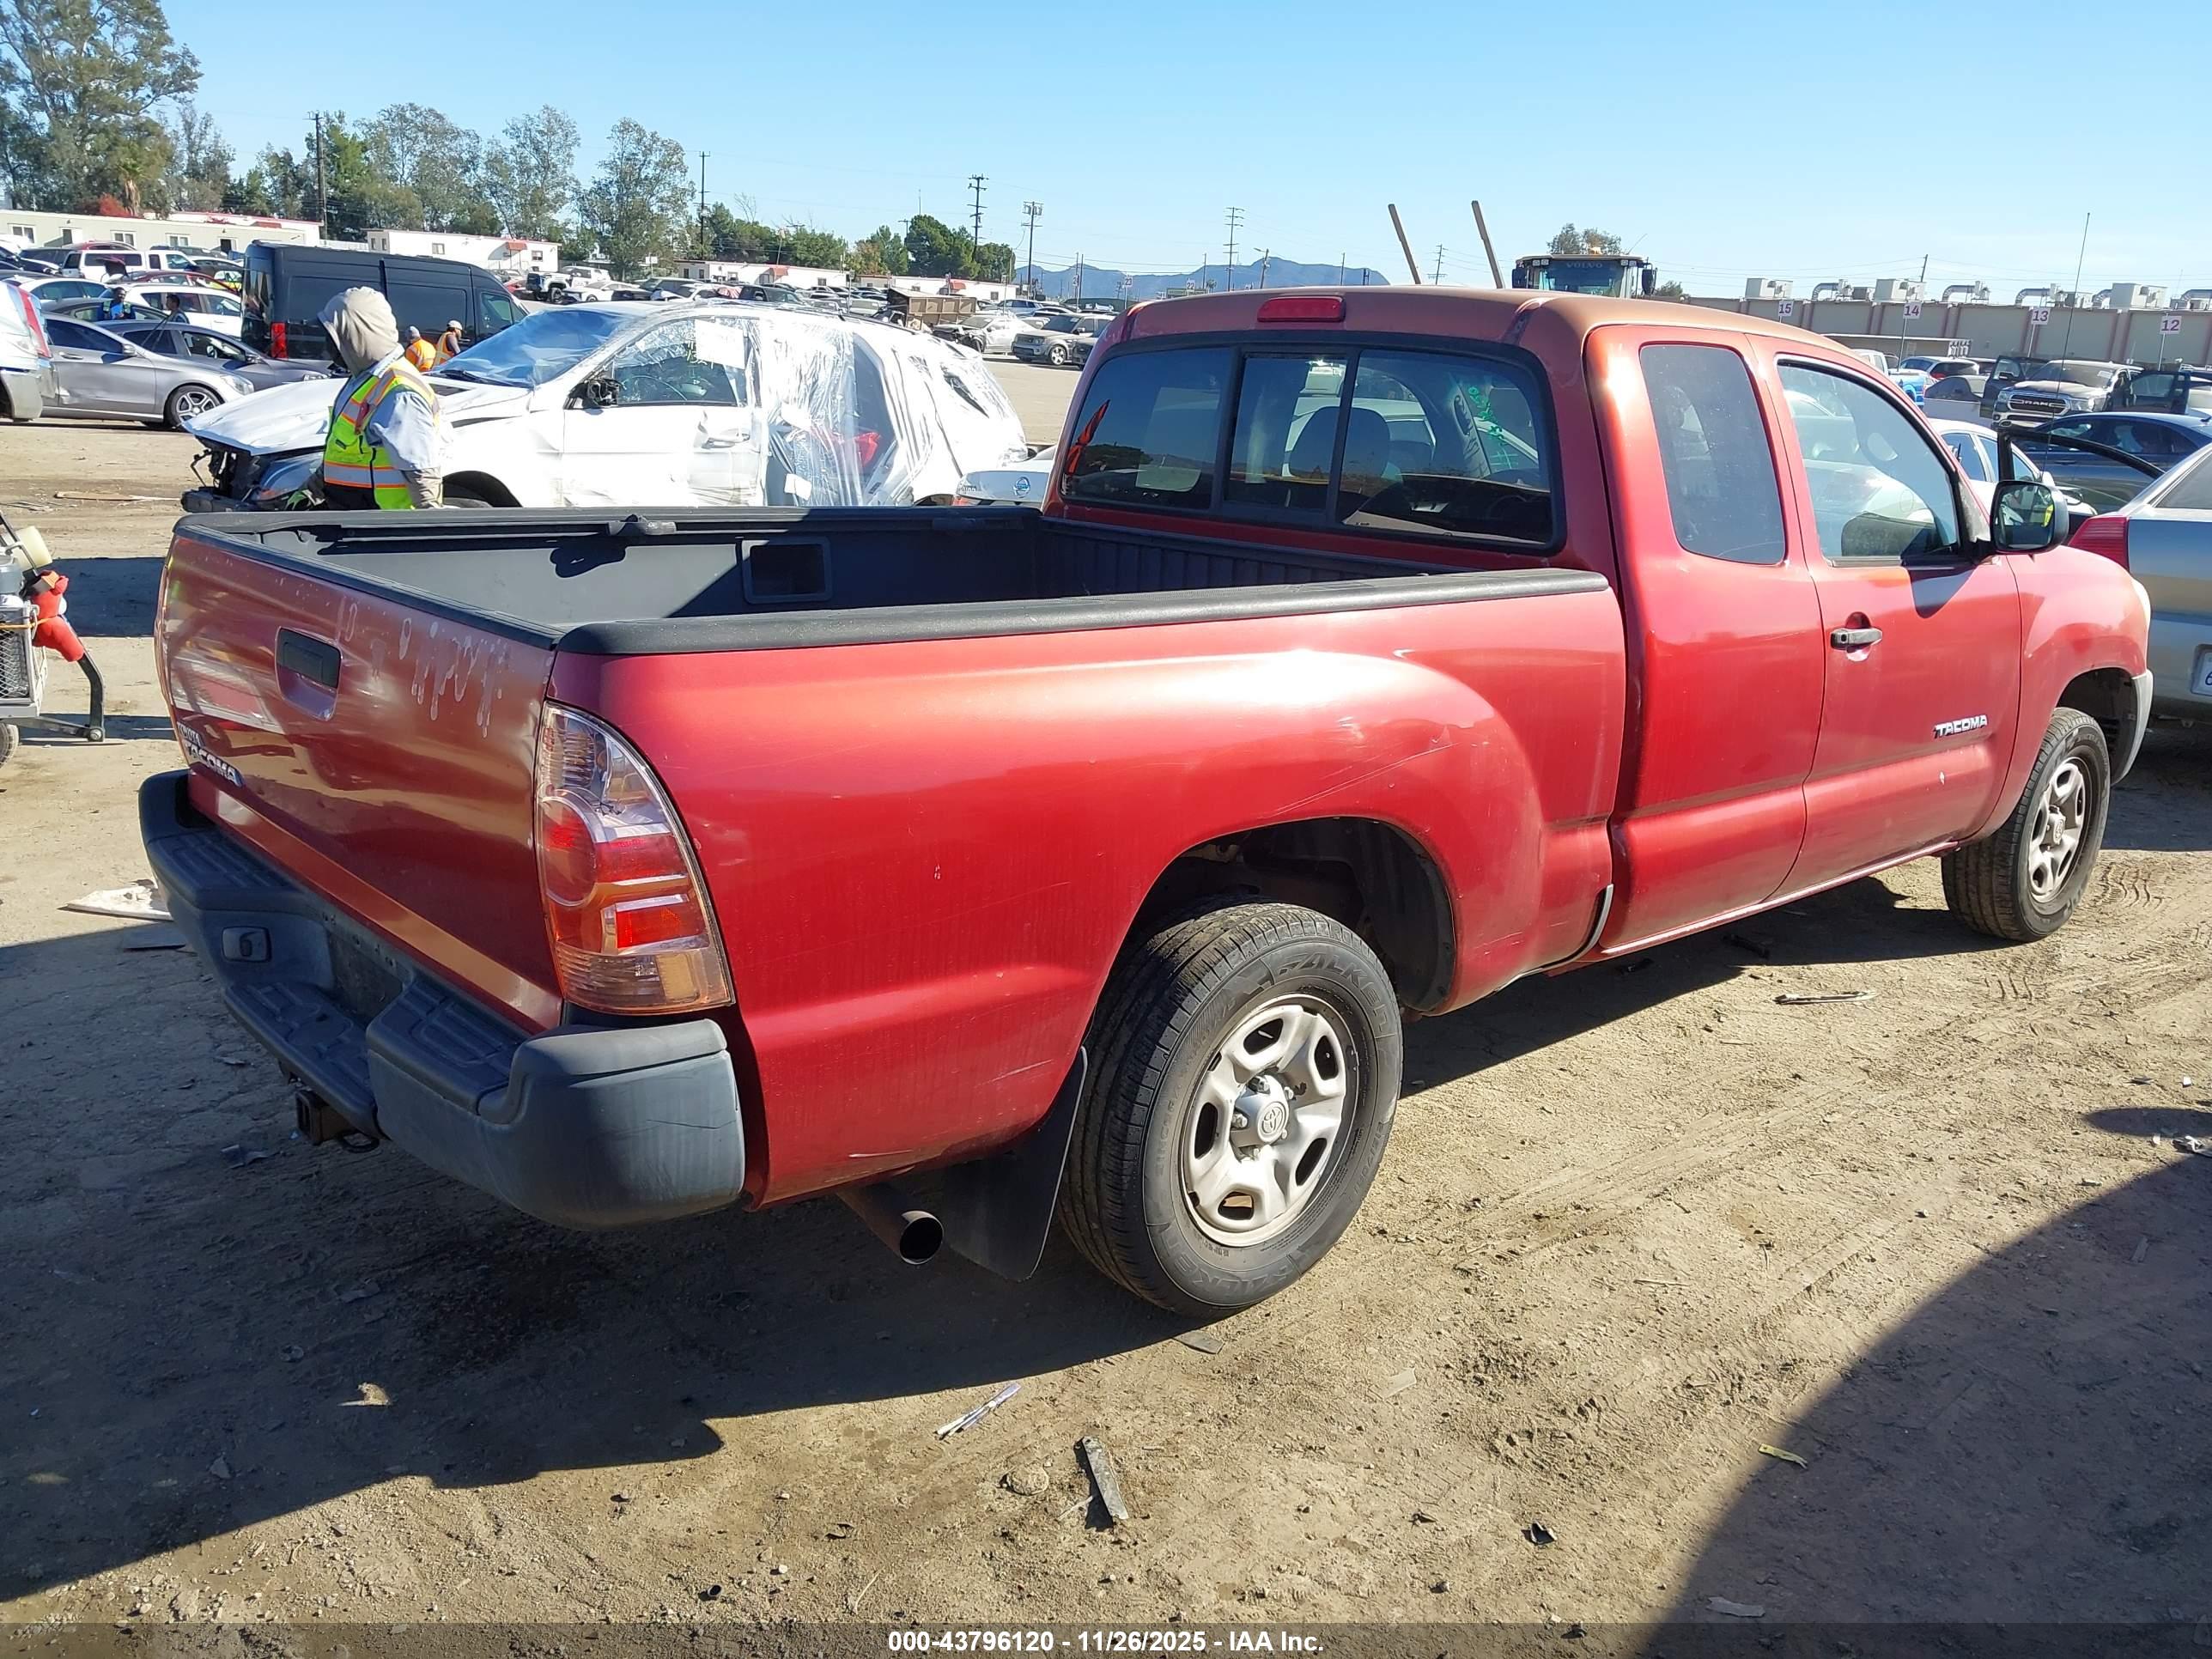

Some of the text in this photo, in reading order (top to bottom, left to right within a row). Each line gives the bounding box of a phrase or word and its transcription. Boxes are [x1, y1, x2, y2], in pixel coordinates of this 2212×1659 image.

[1779, 303, 1792, 314] 15
[1905, 305, 1919, 317] 14
[2033, 310, 2048, 322] 13
[2161, 319, 2179, 331] 12
[1935, 714, 1988, 738] TACOMA
[177, 722, 199, 744] TOYOTA
[185, 742, 242, 787] TACOMA
